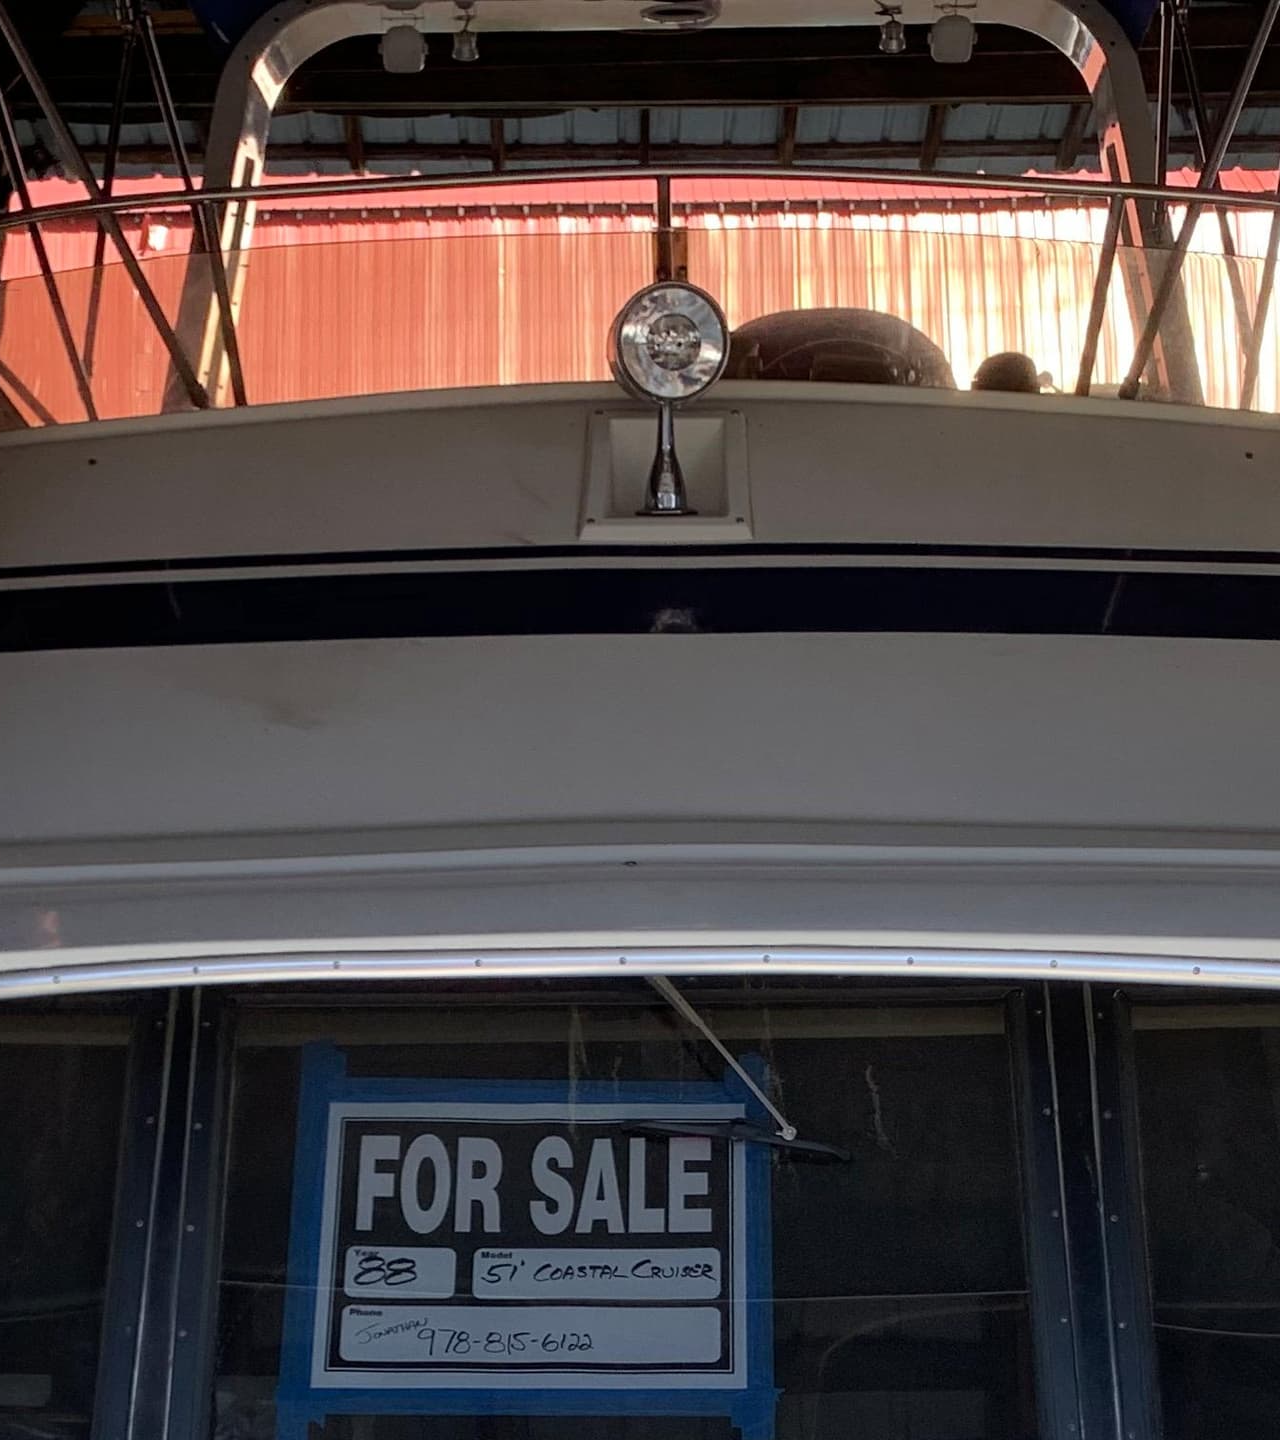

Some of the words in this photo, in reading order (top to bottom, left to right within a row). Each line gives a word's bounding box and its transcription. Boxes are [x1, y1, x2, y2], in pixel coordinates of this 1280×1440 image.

[355, 1133, 504, 1235] FOR
[529, 1135, 713, 1236] SALE
[480, 1251, 513, 1260] Model
[353, 1256, 417, 1286] 88
[532, 1263, 629, 1282] COASTAL
[631, 1259, 717, 1282] CRUISER
[349, 1308, 384, 1317] Phone
[417, 1327, 594, 1356] 978-815-6122
